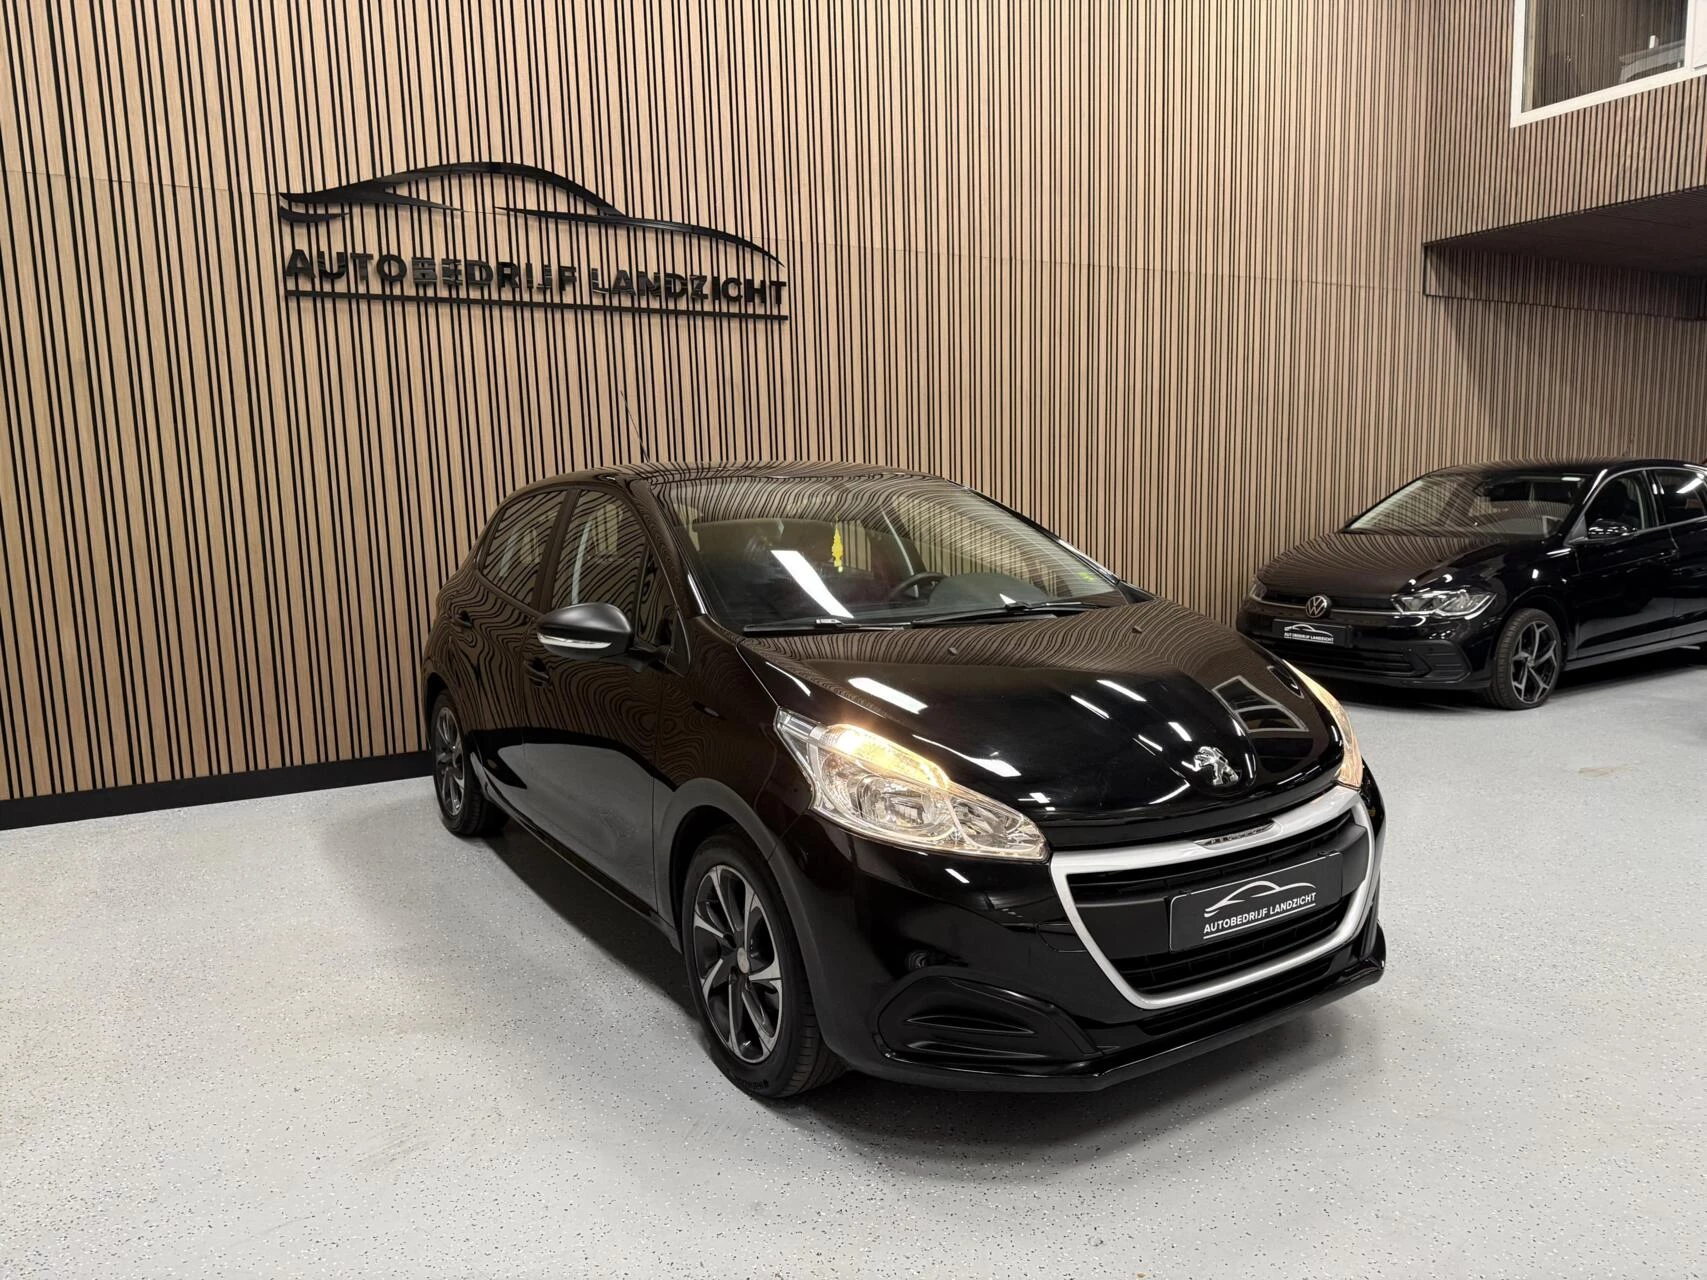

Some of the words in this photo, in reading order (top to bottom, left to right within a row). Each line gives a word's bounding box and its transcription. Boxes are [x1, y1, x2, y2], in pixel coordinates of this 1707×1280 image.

[285, 247, 578, 292] AUTOBEDRIJF
[590, 266, 788, 306] LANDZICHT
[1203, 909, 1268, 934] AUTOBEDRIJF
[1269, 892, 1317, 915] LANDZICHT
